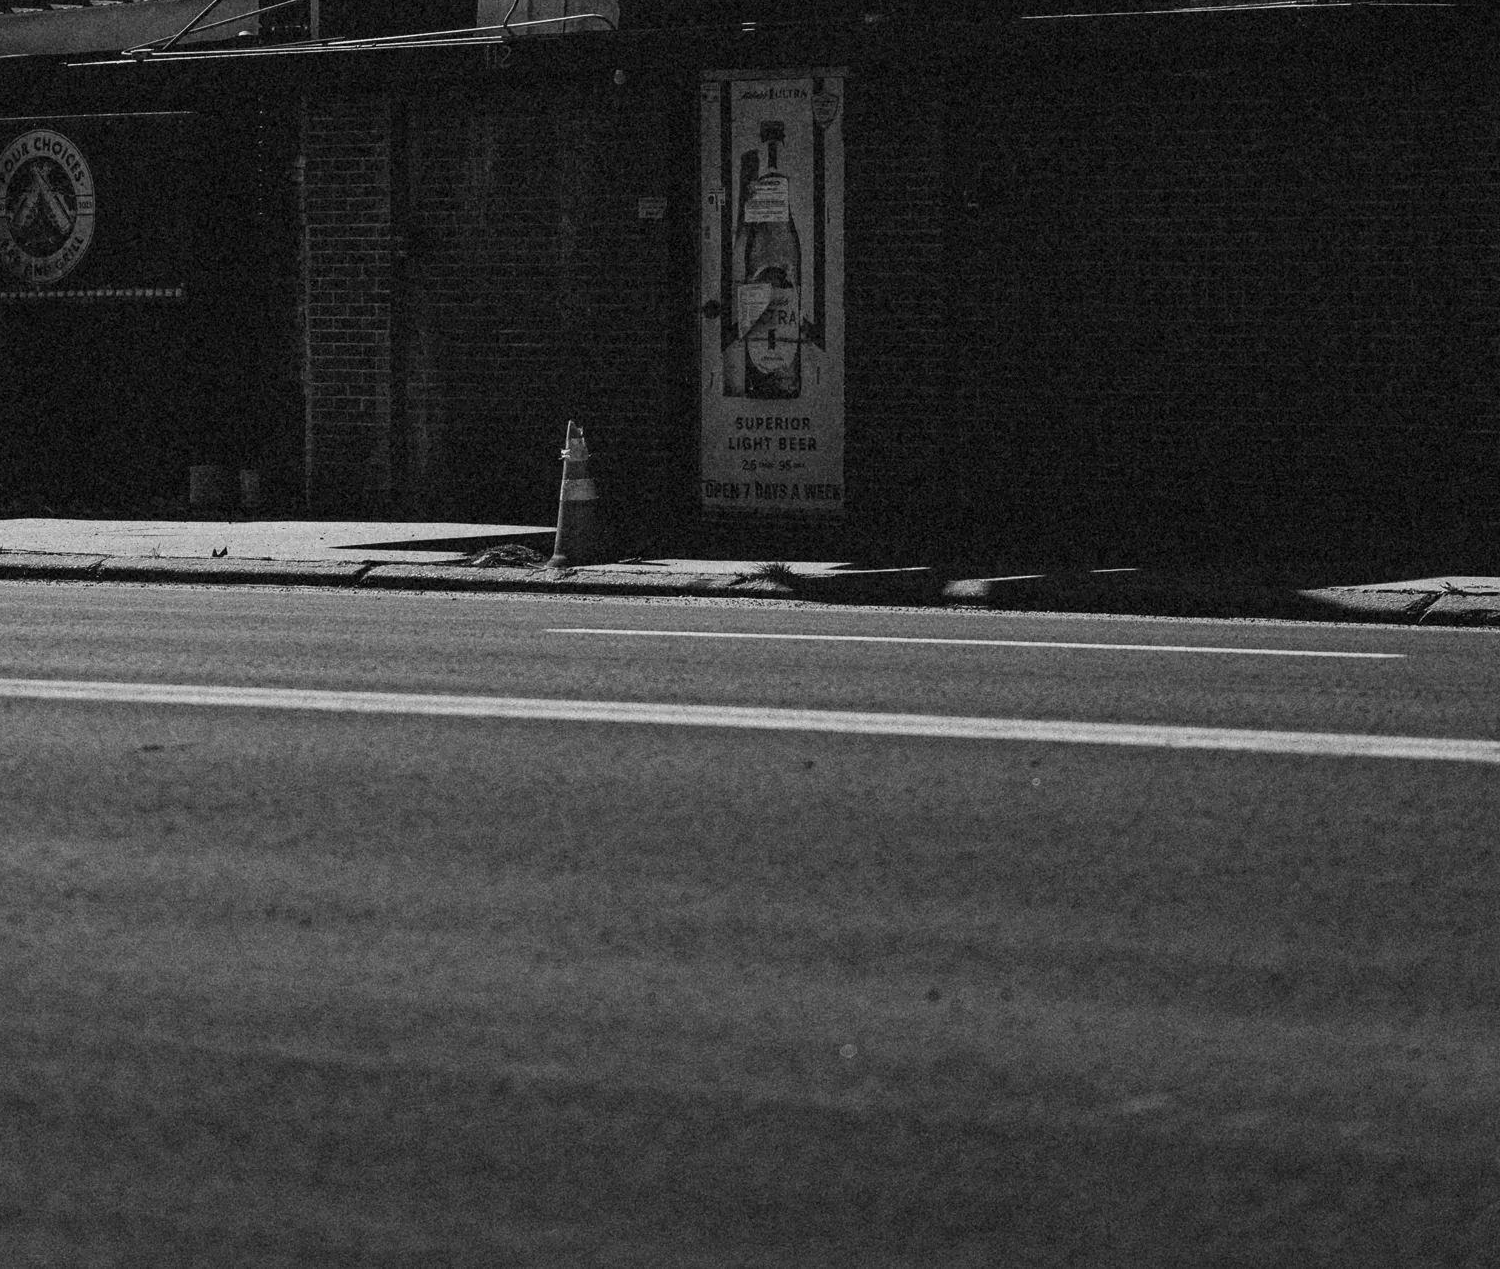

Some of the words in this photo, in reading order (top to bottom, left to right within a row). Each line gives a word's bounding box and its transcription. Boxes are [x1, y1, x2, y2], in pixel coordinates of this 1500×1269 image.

[775, 88, 808, 99] ULTRA
[0, 142, 31, 184] POUR
[33, 136, 86, 183] CHOICES
[55, 236, 85, 271] GRILL
[735, 416, 811, 430] SUPERIOR
[728, 437, 772, 451] LIGHT
[778, 437, 818, 451] BEER
[705, 482, 740, 500] OPEN
[743, 483, 751, 500] 7
[755, 481, 788, 501] DAYS
[791, 484, 801, 500] A
[804, 483, 842, 501] WEEK
